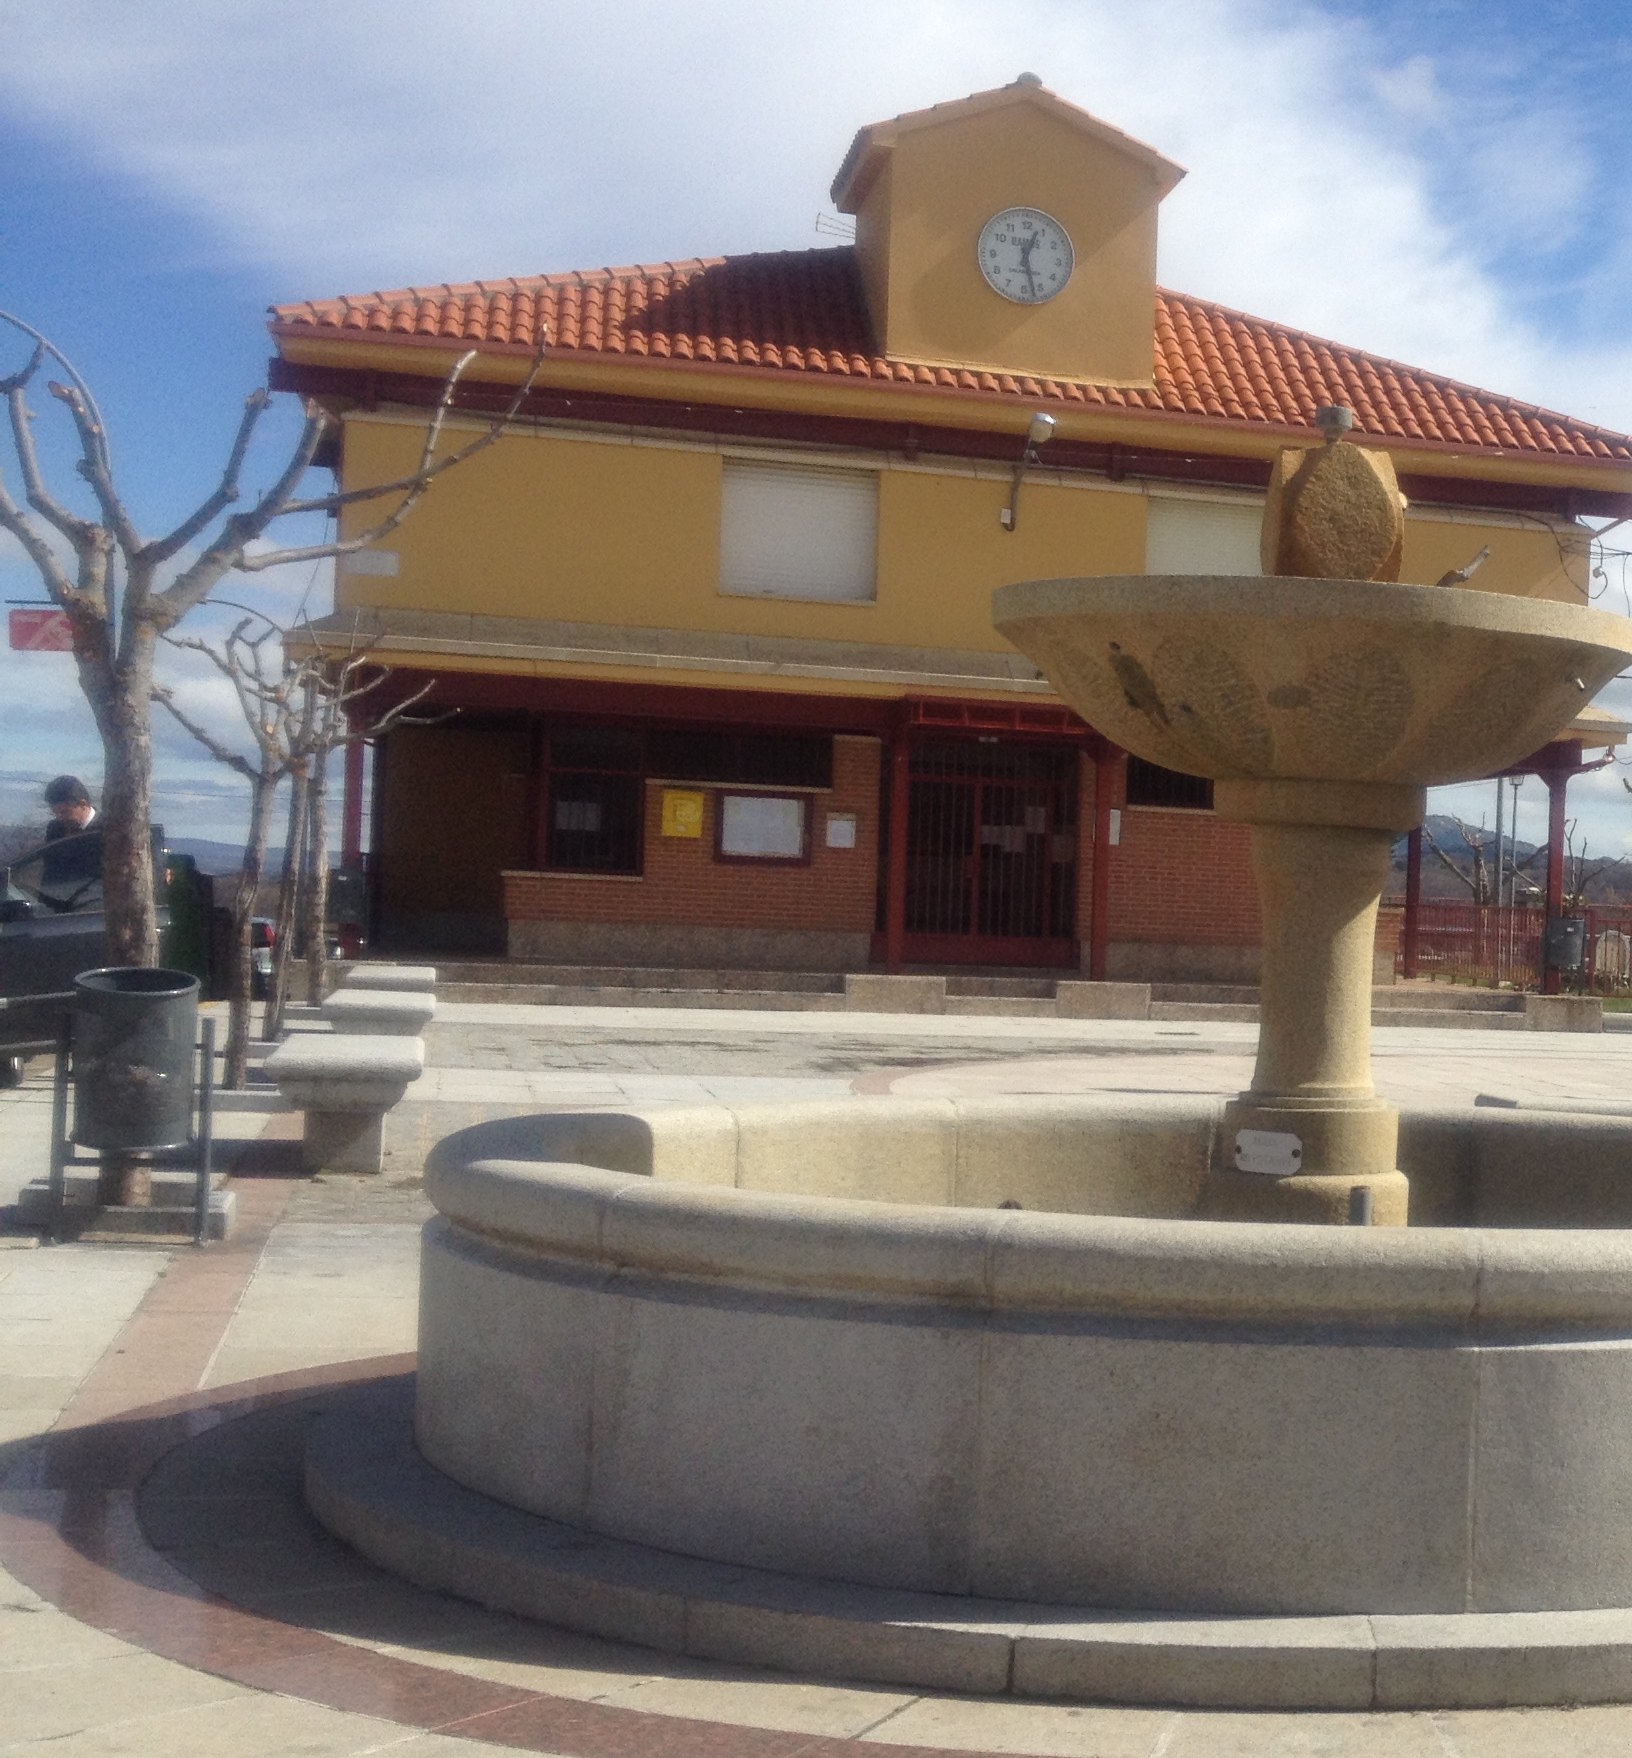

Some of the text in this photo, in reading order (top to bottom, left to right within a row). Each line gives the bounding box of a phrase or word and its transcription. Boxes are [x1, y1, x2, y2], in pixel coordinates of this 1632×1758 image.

[1006, 223, 1015, 233] 11
[1022, 221, 1032, 230] 12
[1041, 228, 1046, 237] 1
[994, 233, 1007, 243] 10
[1050, 240, 1057, 250] 2
[989, 249, 997, 259] 9
[1055, 258, 1062, 267] 3
[993, 265, 1001, 275] 8
[1049, 272, 1056, 281] 4
[1005, 278, 1012, 287] 7
[1020, 285, 1028, 294] 6
[1037, 283, 1044, 292] 5
